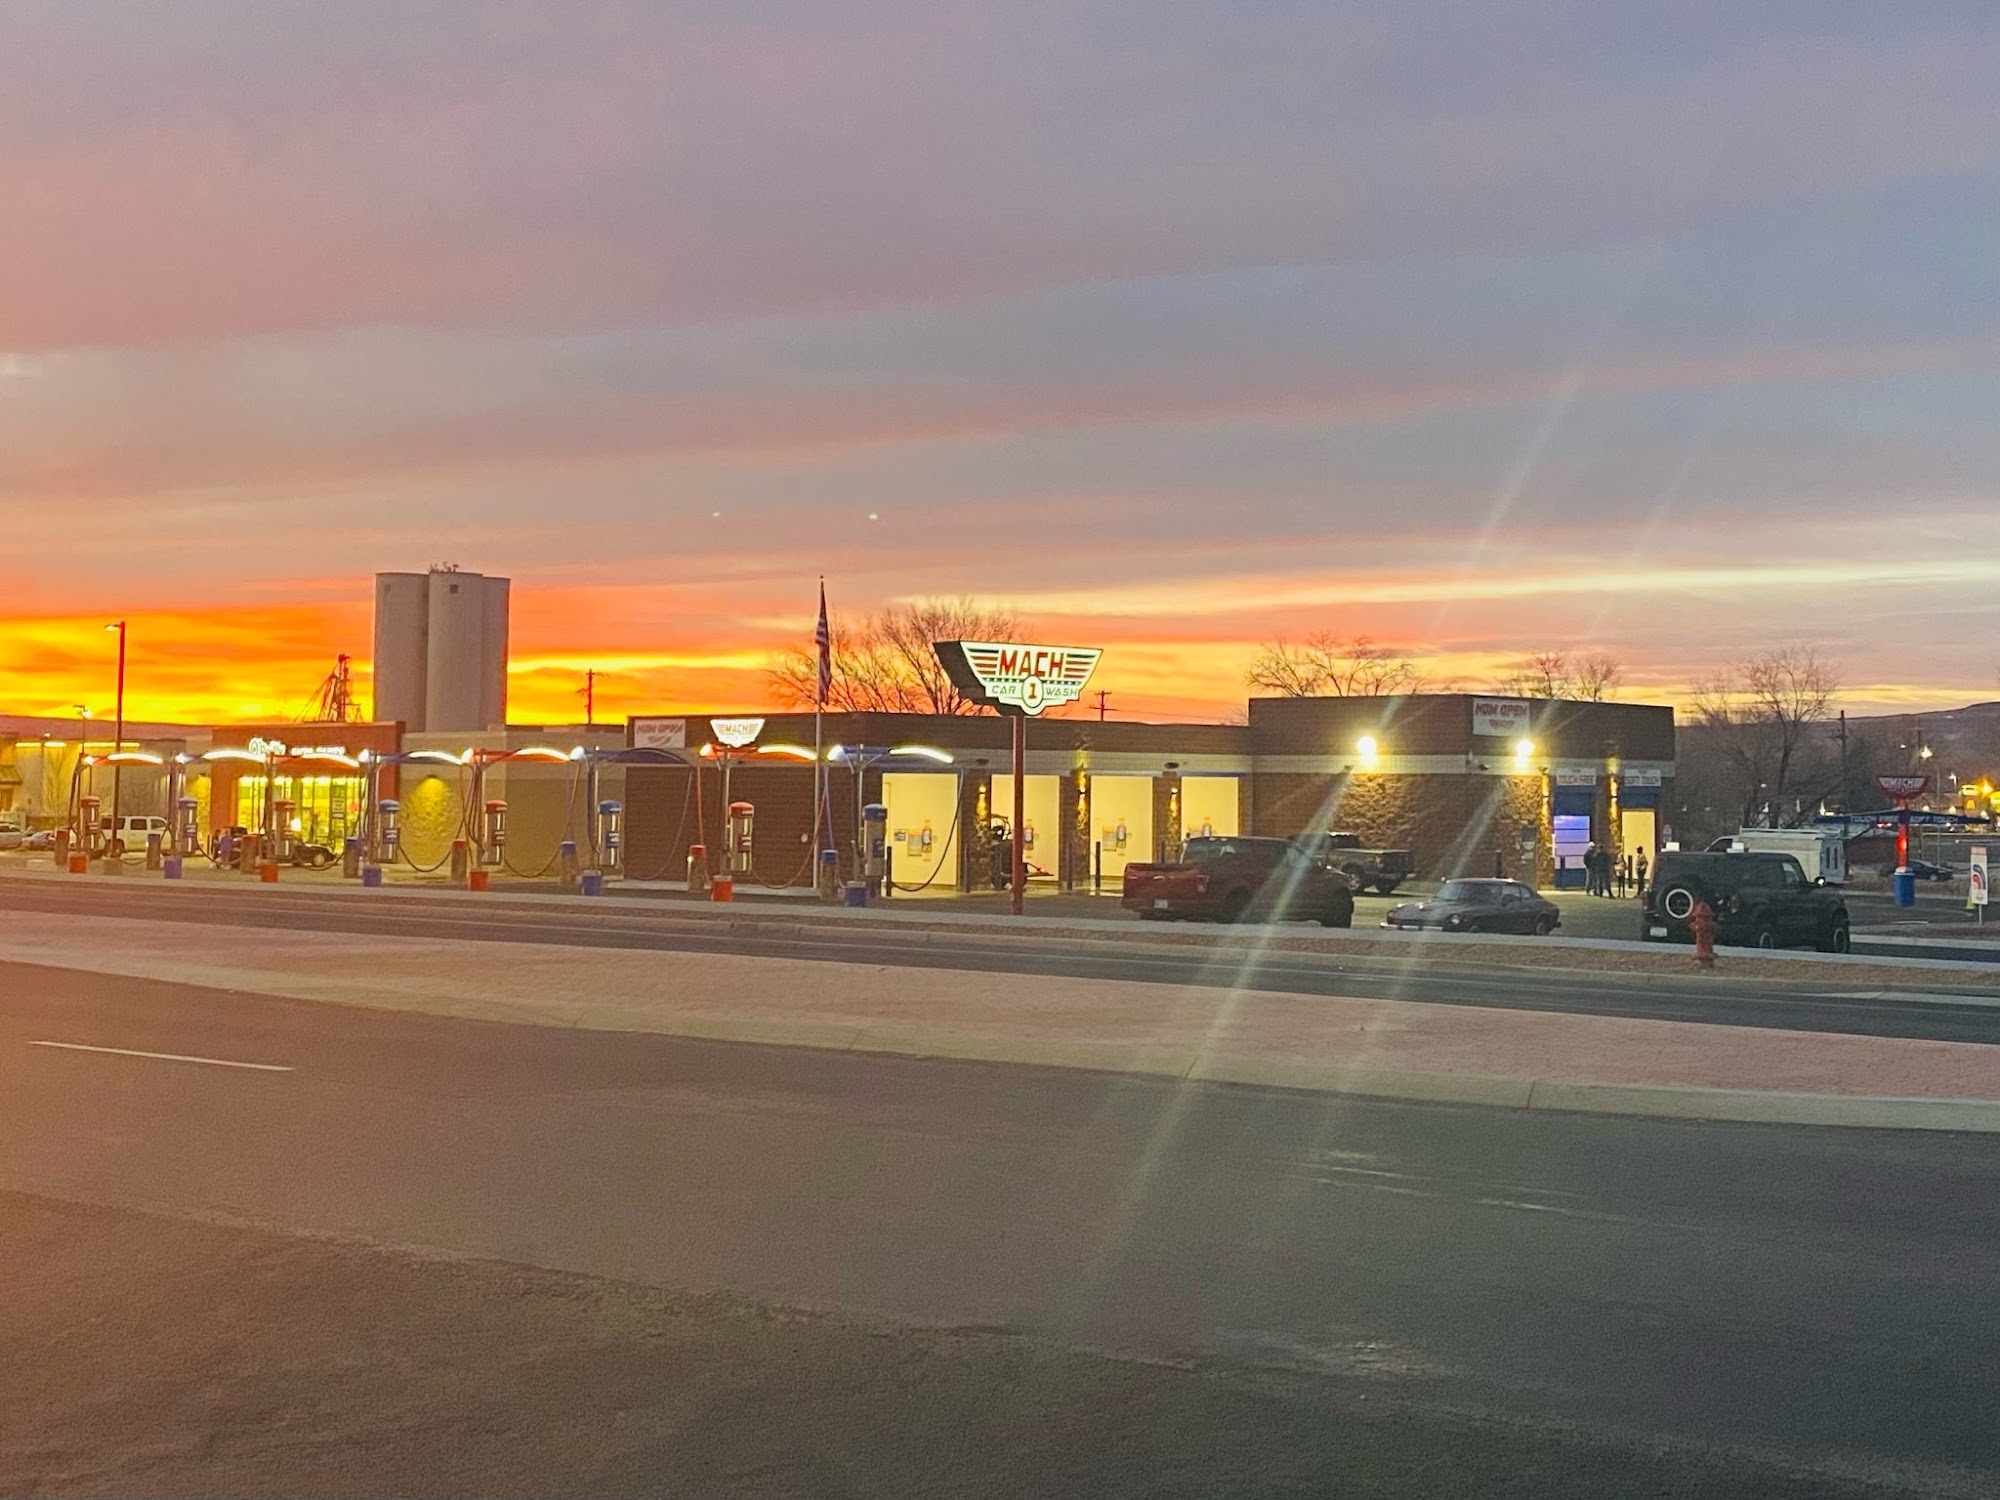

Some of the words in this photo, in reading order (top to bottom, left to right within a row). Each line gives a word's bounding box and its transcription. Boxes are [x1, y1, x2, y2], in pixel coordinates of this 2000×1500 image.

[998, 650, 1064, 678] MACH
[992, 685, 1016, 694] CAR
[1028, 683, 1037, 699] 1
[1046, 687, 1078, 697] WASH
[1500, 704, 1528, 718] OPEN
[725, 724, 748, 732] MACH
[1850, 815, 1877, 823] TOUCH
[1878, 815, 1900, 823] FREE
[1910, 815, 1931, 823] SOFT
